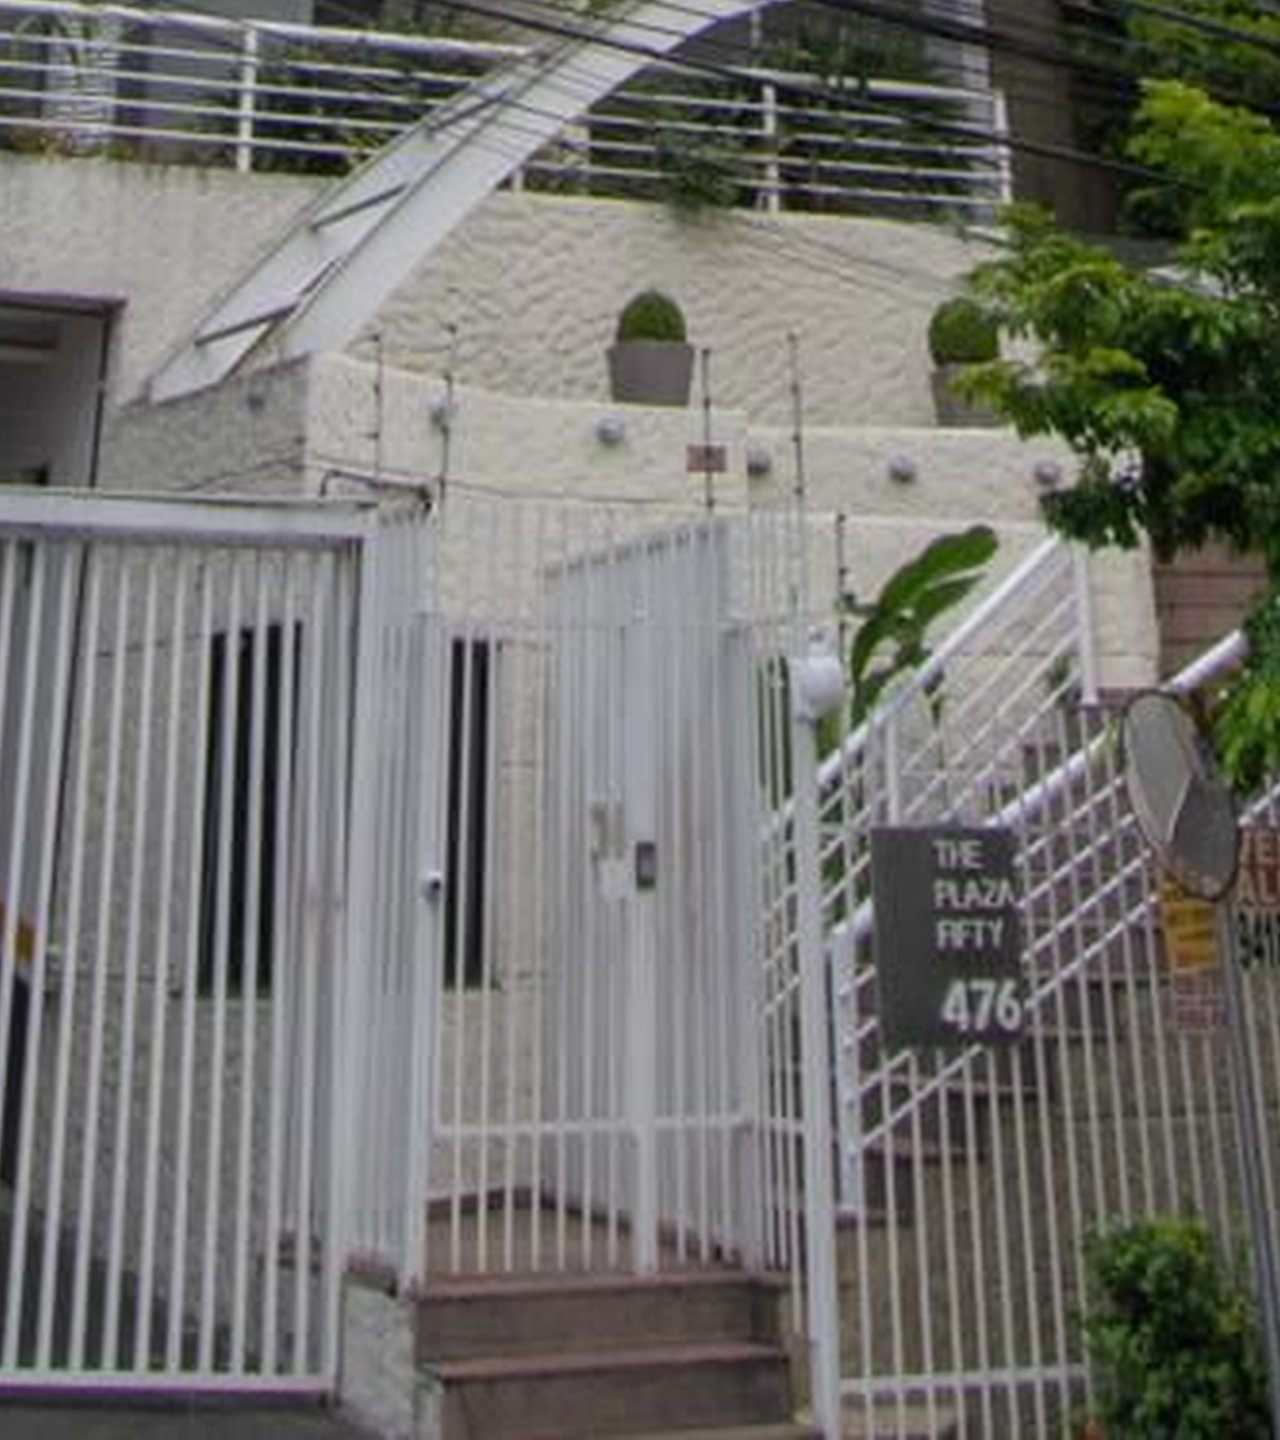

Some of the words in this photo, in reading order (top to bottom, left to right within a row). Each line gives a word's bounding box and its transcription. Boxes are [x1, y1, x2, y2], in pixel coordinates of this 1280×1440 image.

[932, 839, 984, 870] THE
[934, 878, 1015, 909] PLAZA
[936, 919, 1004, 950] FIFTY
[942, 979, 1022, 1031] 476
